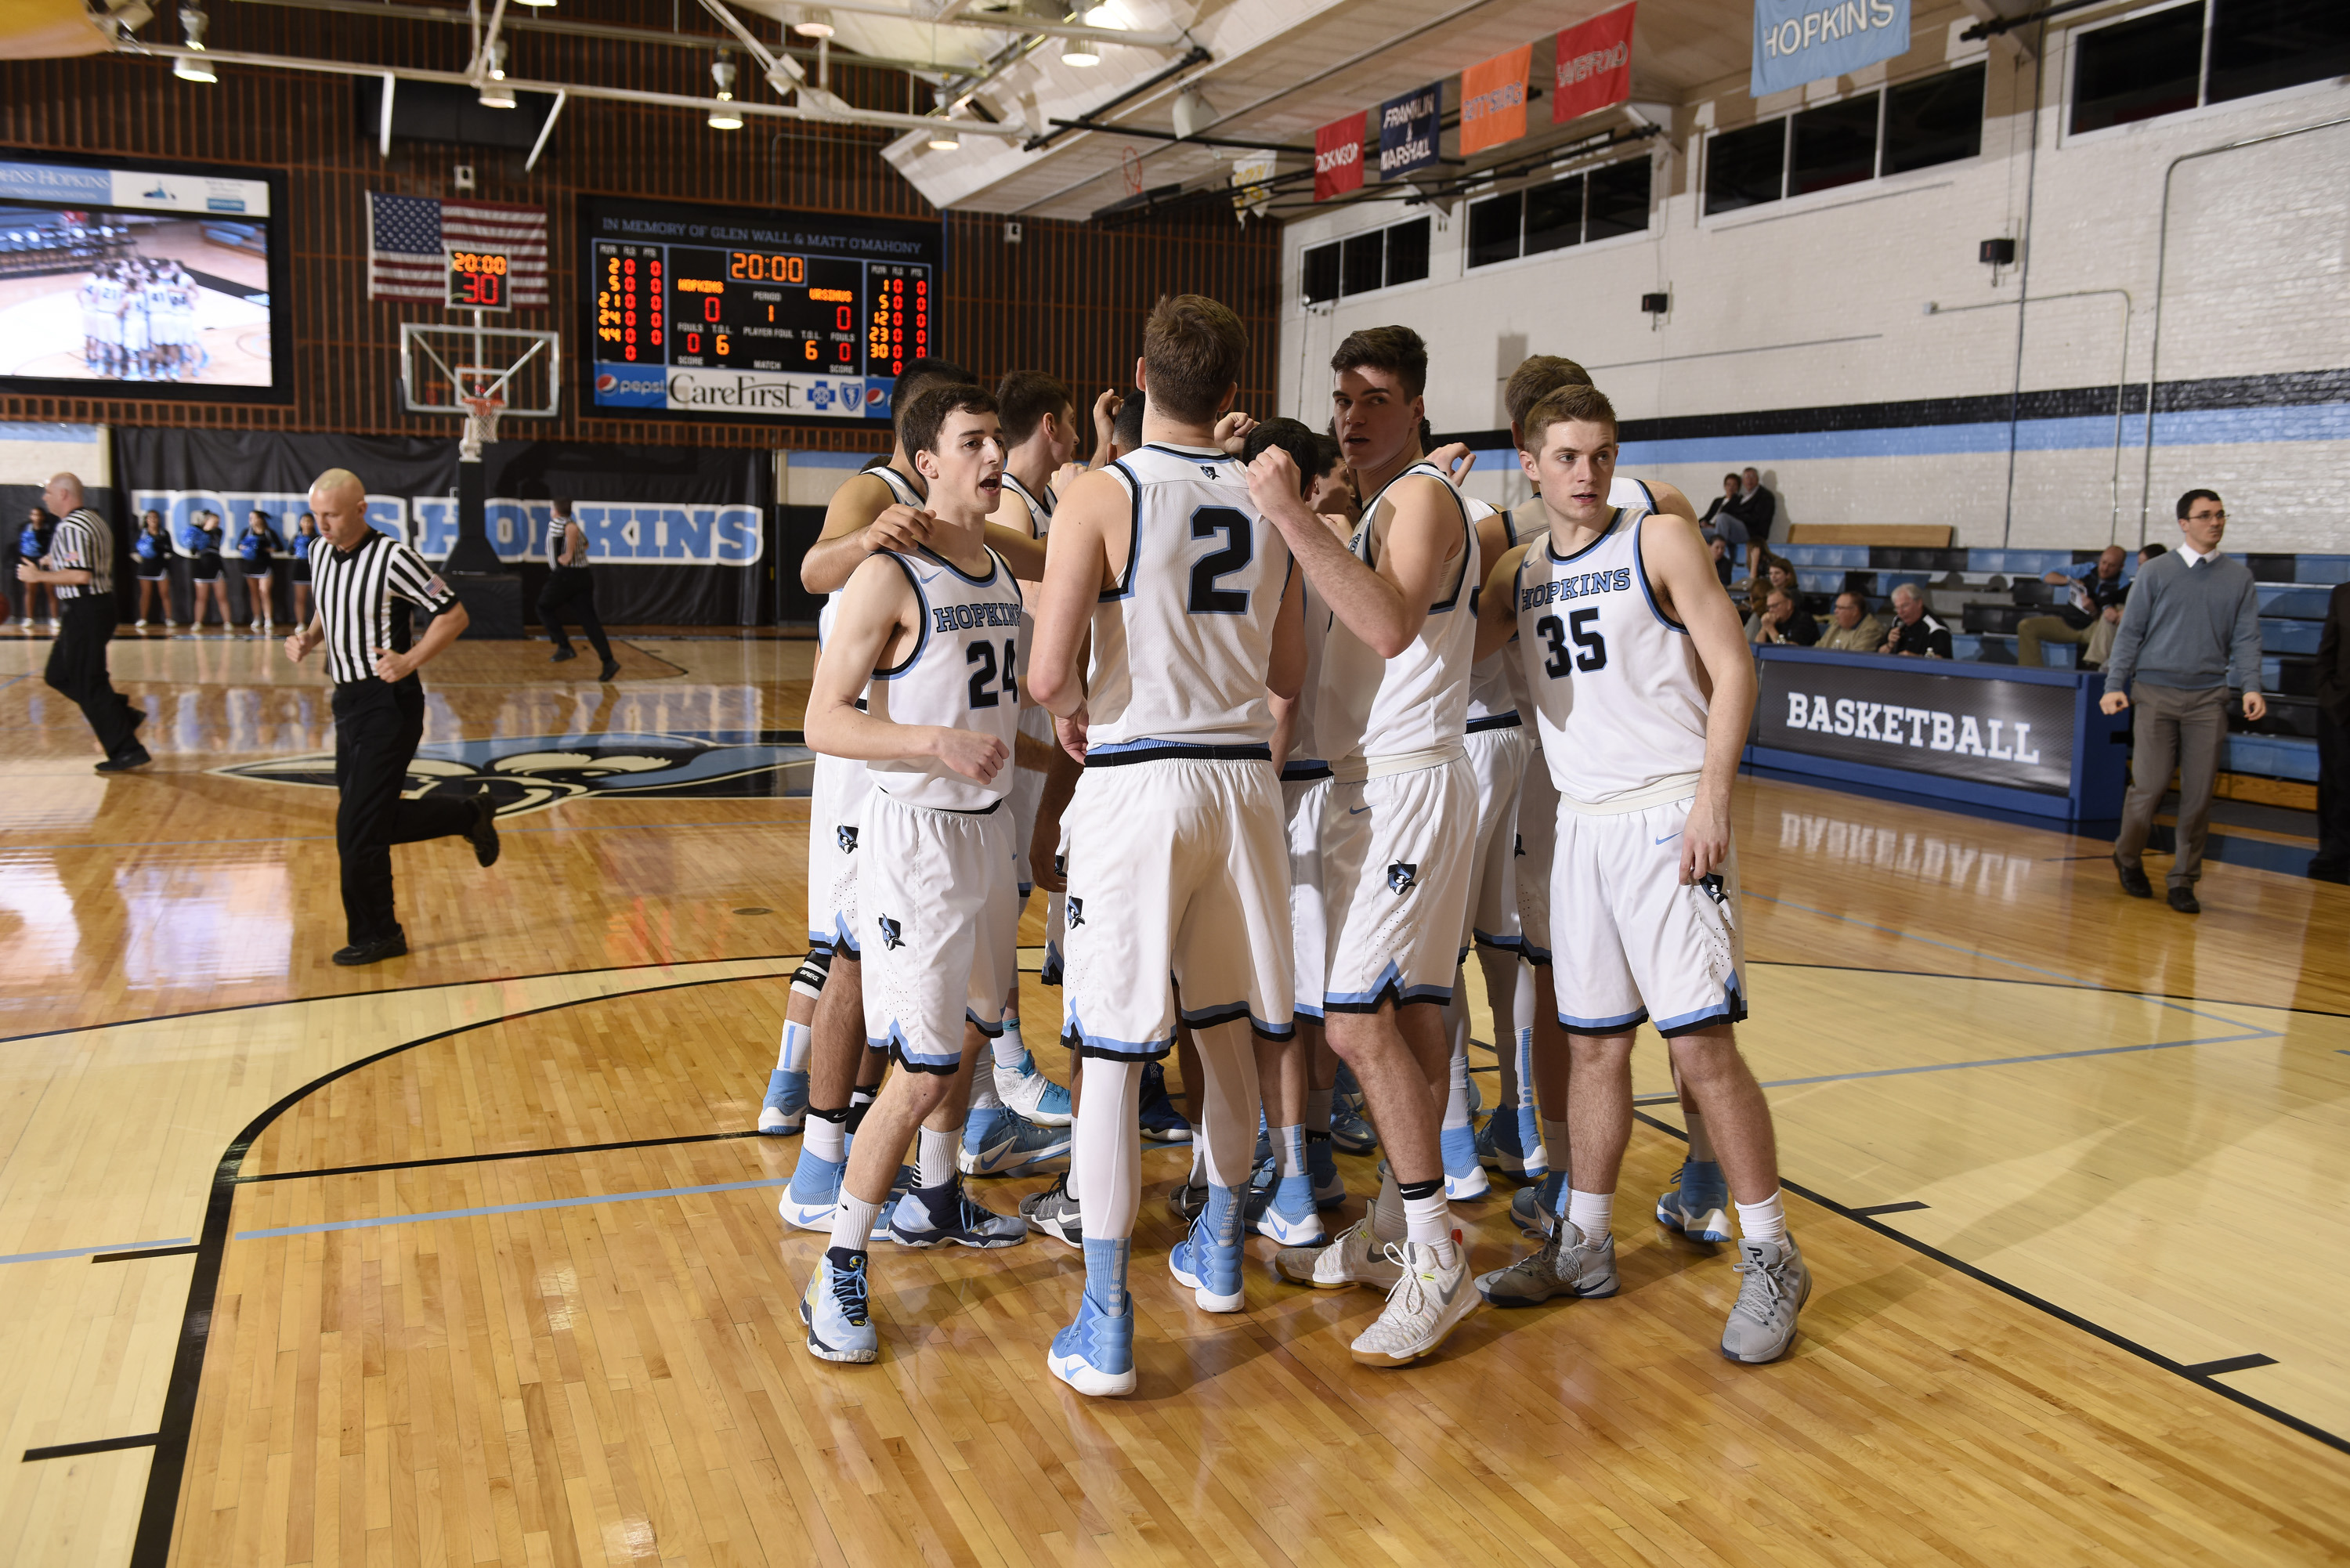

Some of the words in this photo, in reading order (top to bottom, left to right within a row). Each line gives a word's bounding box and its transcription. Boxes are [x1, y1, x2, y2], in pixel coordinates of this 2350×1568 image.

[1764, 0, 1896, 60] HOPKINS
[603, 217, 619, 230] IN
[622, 219, 686, 236] MEMORY
[689, 225, 708, 237] OF
[711, 226, 748, 240] GLEN
[751, 229, 790, 243] WALL
[807, 234, 847, 248] MATT
[453, 252, 507, 275] 20:00
[609, 258, 620, 274] 2
[624, 258, 635, 275] 0
[650, 261, 661, 276] 0
[732, 253, 804, 283] 20:00
[463, 273, 498, 305] 30
[624, 276, 636, 292] 0
[650, 278, 661, 294] 0
[893, 279, 903, 294] 0
[916, 280, 926, 295] 0
[598, 291, 620, 308] 21
[624, 294, 636, 309] 0
[651, 295, 662, 311] 0
[753, 291, 782, 302] PERIOD
[893, 295, 903, 310] 0
[916, 297, 926, 312] 0
[705, 296, 721, 323] 0
[768, 305, 775, 323] 1
[625, 311, 636, 327] 0
[651, 313, 662, 328] 0
[837, 305, 851, 331] 0
[874, 311, 889, 326] 12
[893, 312, 903, 327] 0
[916, 313, 926, 328] 0
[625, 328, 636, 344] 0
[678, 322, 703, 334] FOULS
[743, 327, 772, 338] PLAYER
[774, 328, 794, 339] FOUL
[869, 327, 889, 341] 23
[893, 328, 902, 343] 0
[651, 329, 662, 345] 0
[687, 333, 700, 352] 0
[716, 334, 729, 356] 6
[830, 331, 855, 343] FOULS
[916, 330, 926, 344] 0
[625, 345, 636, 361] 0
[805, 340, 818, 360] 6
[839, 342, 851, 362] 0
[870, 343, 889, 359] 30
[893, 345, 902, 359] 0
[678, 355, 703, 367] SCORE
[754, 359, 781, 370] MATCH
[830, 363, 854, 374] SCORE
[892, 360, 902, 375] 0
[620, 379, 666, 396] pepsi
[669, 373, 797, 409] CareFirst
[132, 490, 407, 558] JOHS
[1188, 504, 1253, 615] 2
[1521, 568, 1630, 612] HOPKINS
[1536, 605, 1608, 680] 35
[965, 638, 1018, 710] 24
[1786, 692, 2039, 764] BASKETBALL
